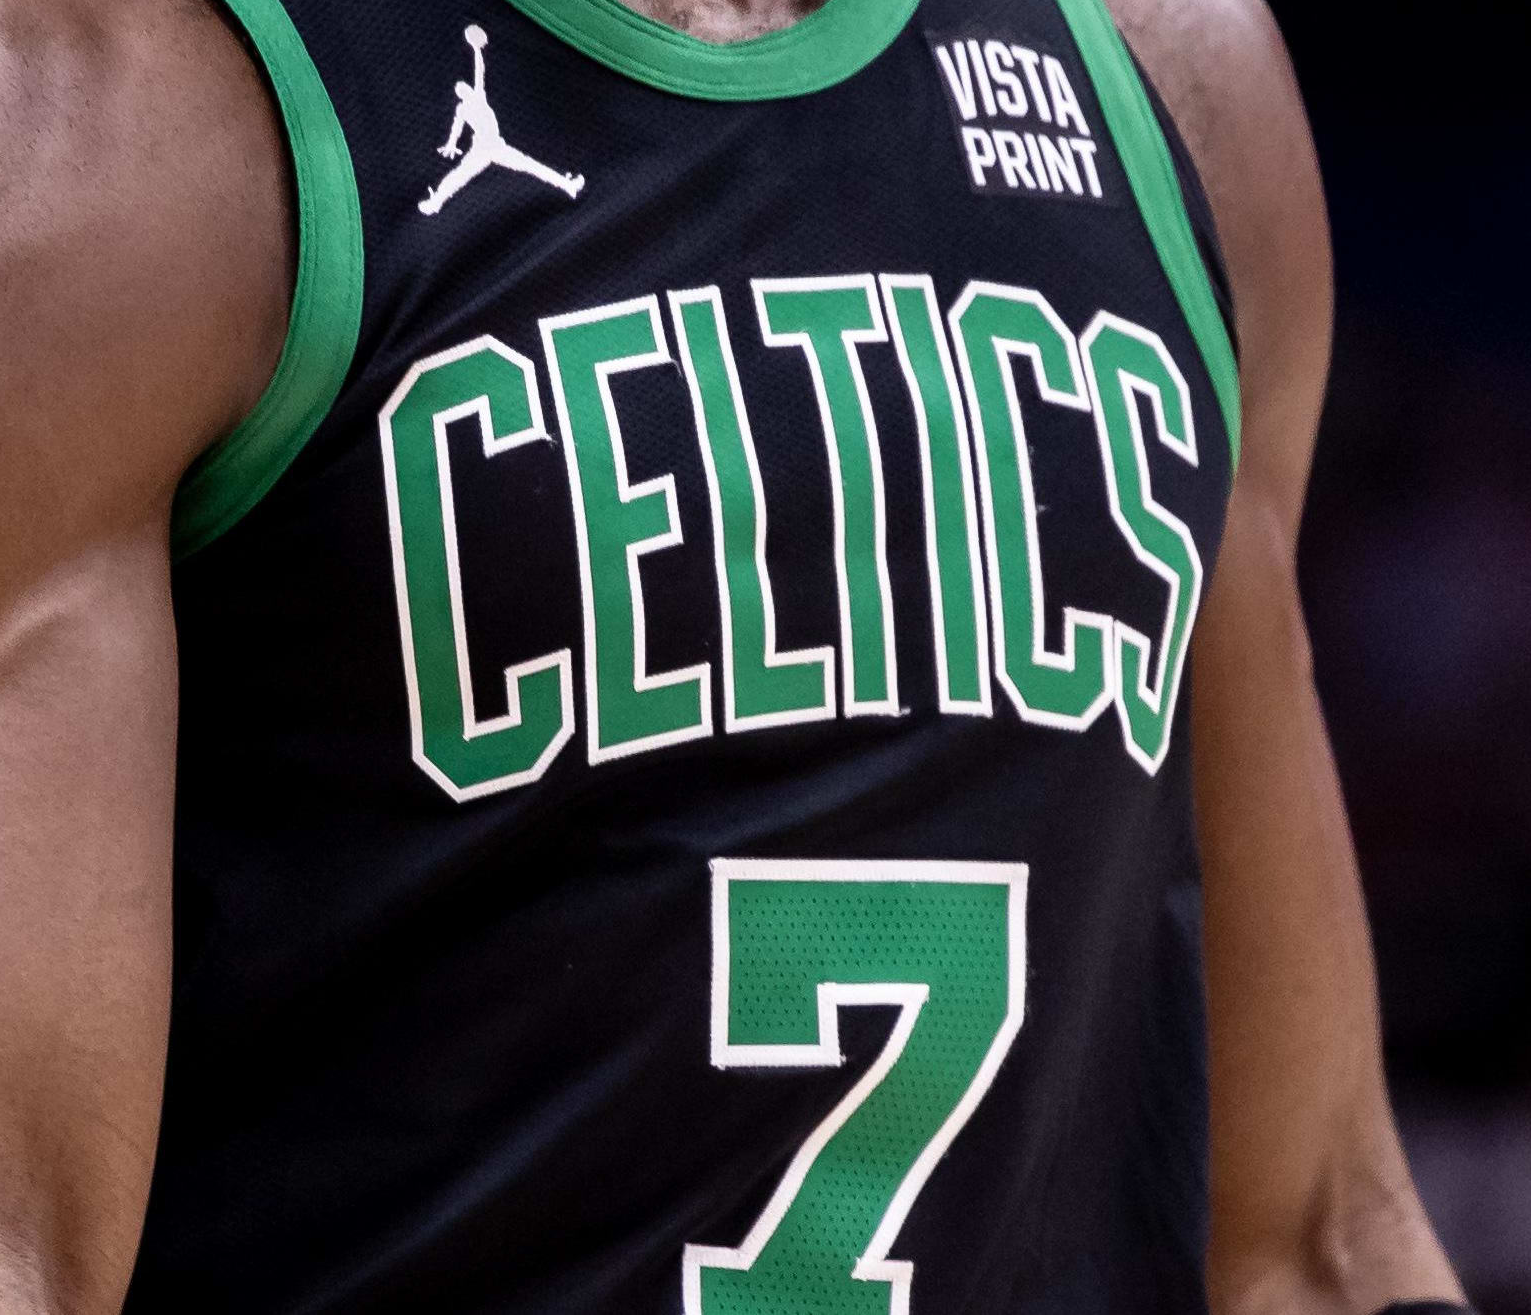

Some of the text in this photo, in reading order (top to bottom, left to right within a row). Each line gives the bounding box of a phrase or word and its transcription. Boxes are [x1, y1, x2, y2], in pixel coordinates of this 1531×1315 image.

[935, 38, 1092, 137] VISTA
[961, 125, 1103, 199] PRINT
[380, 273, 1204, 803] CELTICS
[682, 857, 1029, 1315] 7
